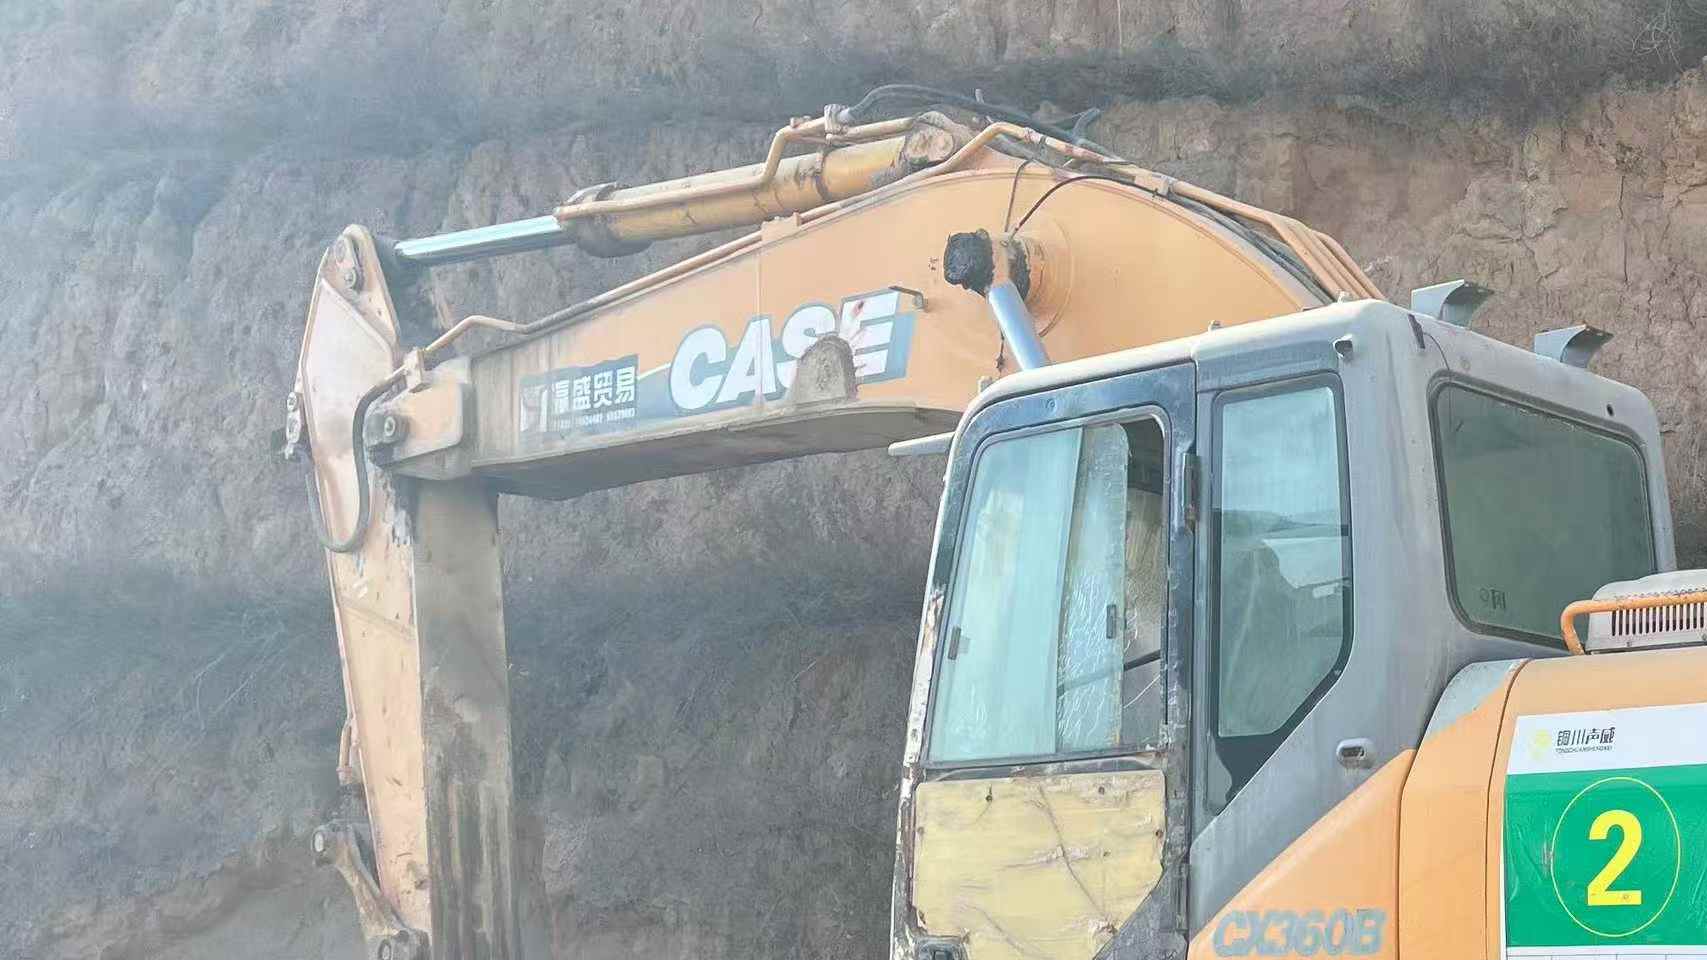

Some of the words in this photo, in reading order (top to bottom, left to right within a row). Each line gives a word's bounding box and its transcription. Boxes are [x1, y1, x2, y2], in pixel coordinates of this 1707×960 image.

[669, 290, 899, 410] CASE
[1587, 809, 1643, 906] 2
[1213, 908, 1386, 957] CX360B
